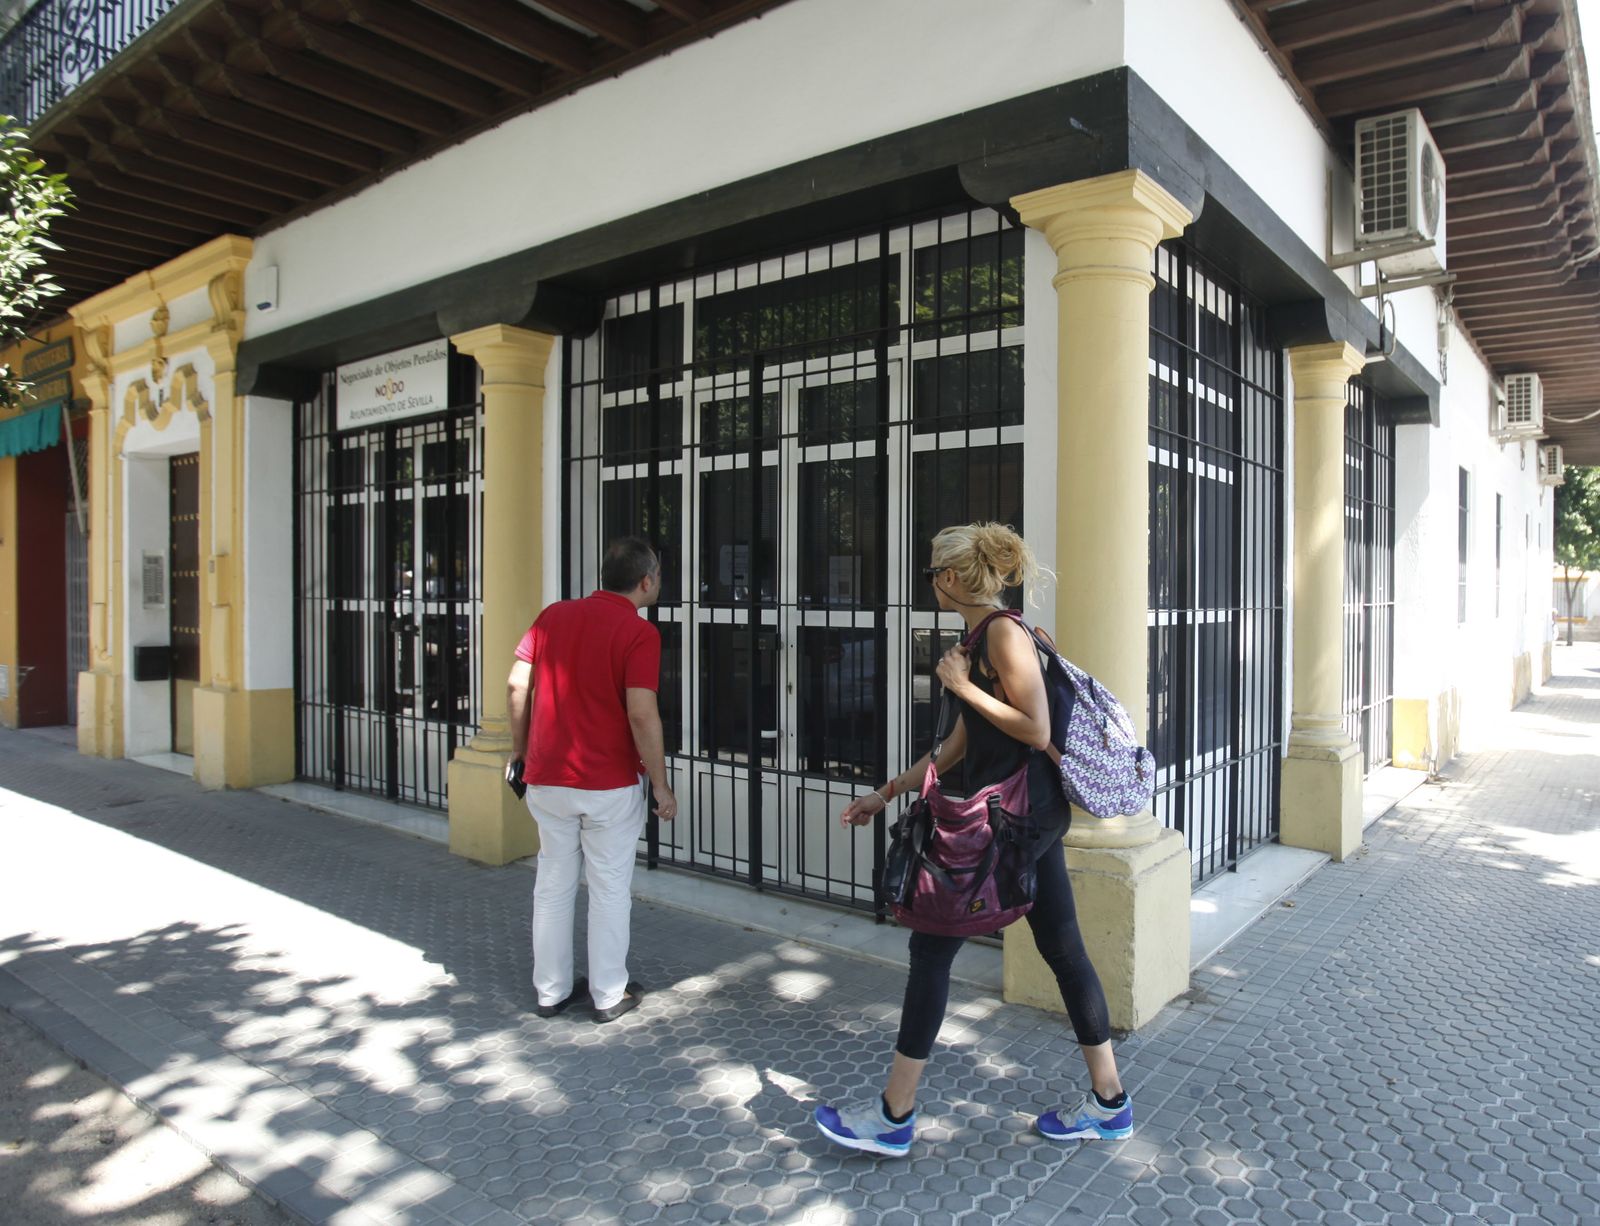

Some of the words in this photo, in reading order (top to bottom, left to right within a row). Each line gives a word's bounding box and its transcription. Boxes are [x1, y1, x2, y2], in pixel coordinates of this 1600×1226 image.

[340, 367, 373, 385] Negociado
[375, 364, 383, 376] de
[384, 358, 412, 372] Objetos
[413, 349, 447, 366] Perdidos
[350, 402, 396, 419] AYUNTAMIENTO
[397, 400, 406, 411] DE
[407, 395, 433, 409] SEVILLA
